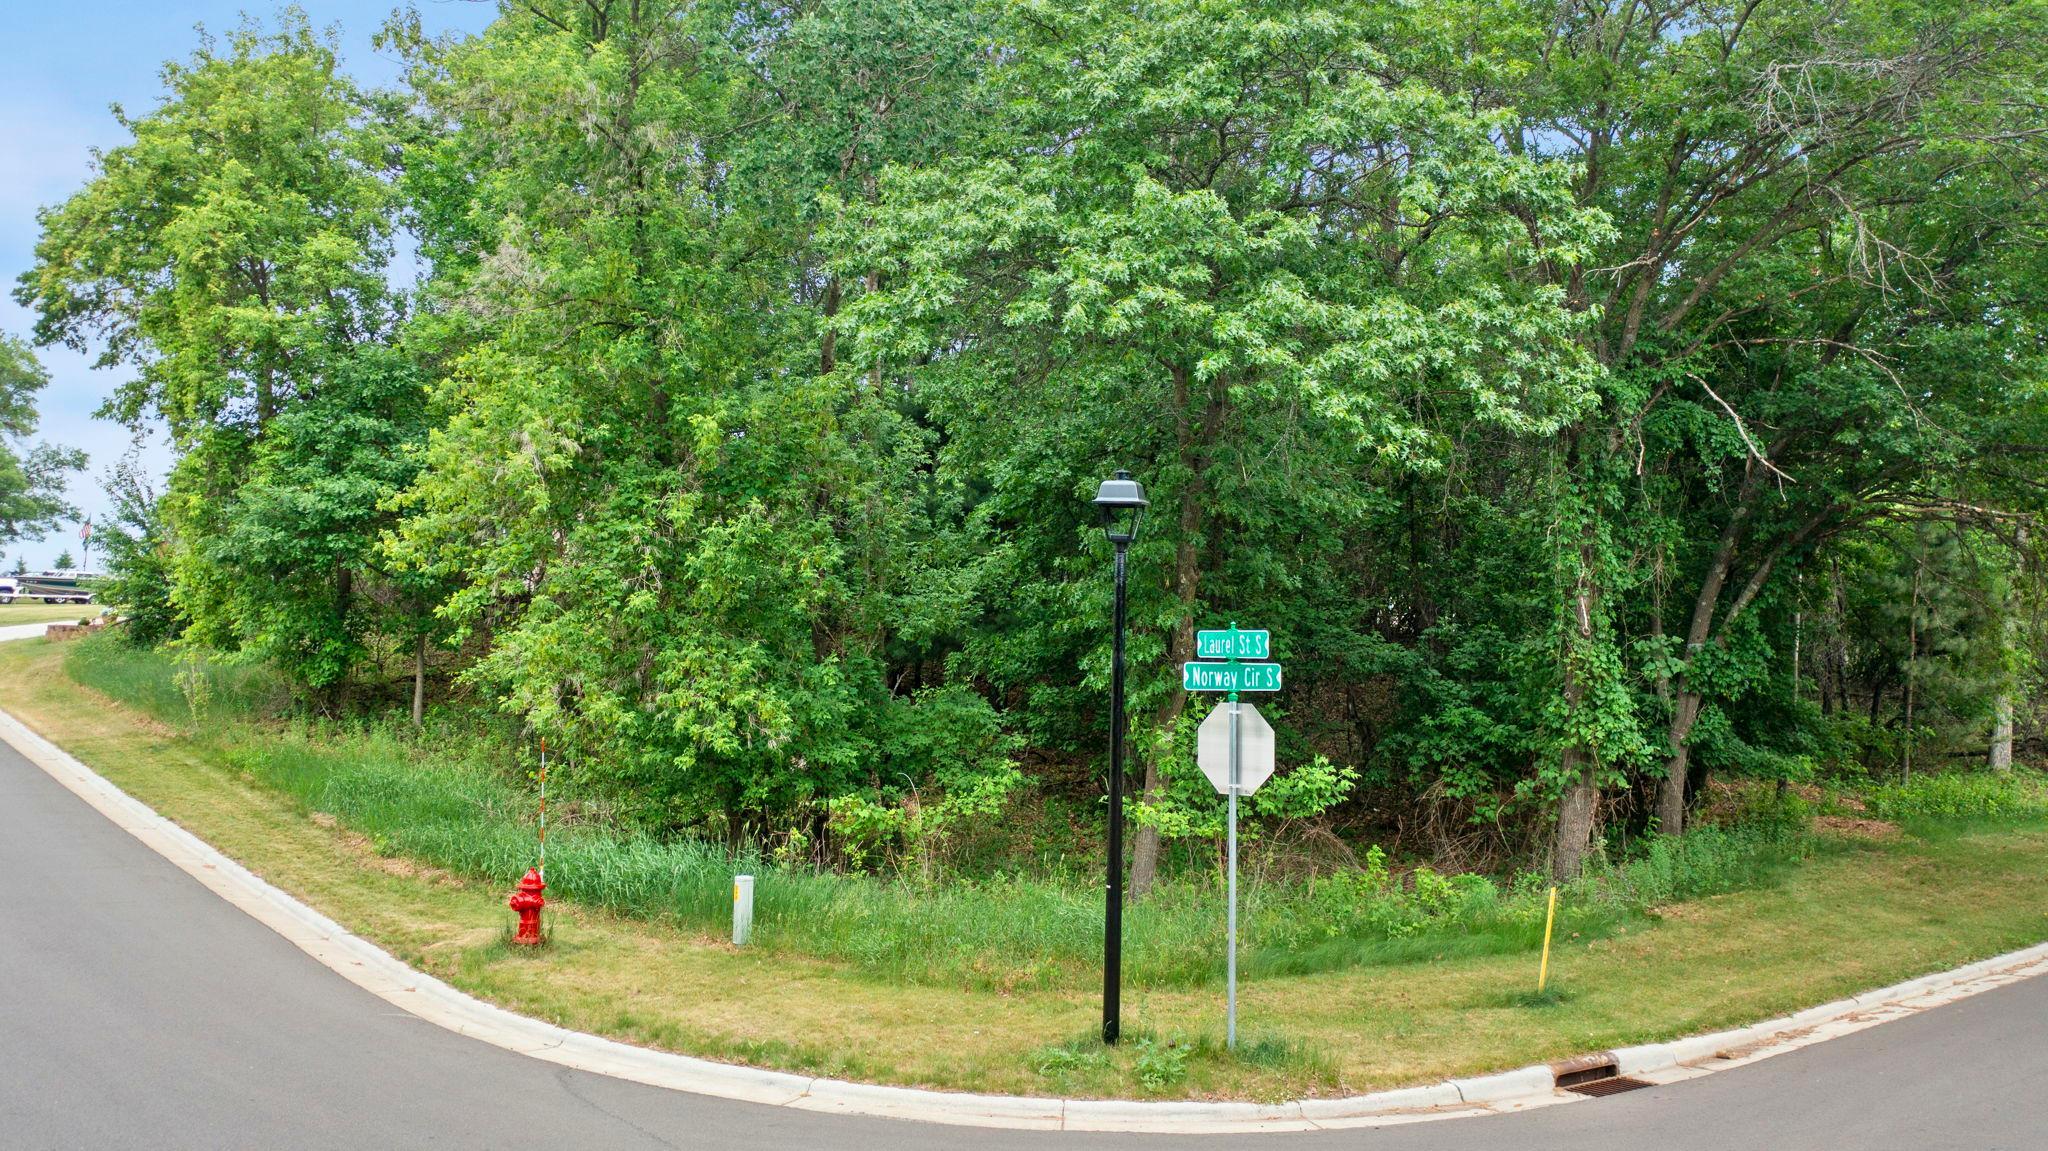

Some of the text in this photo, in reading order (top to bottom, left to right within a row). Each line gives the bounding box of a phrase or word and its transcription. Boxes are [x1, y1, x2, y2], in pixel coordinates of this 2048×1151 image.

[1204, 634, 1262, 655] Laurel St S
[1192, 666, 1273, 689] Norway Cir S
